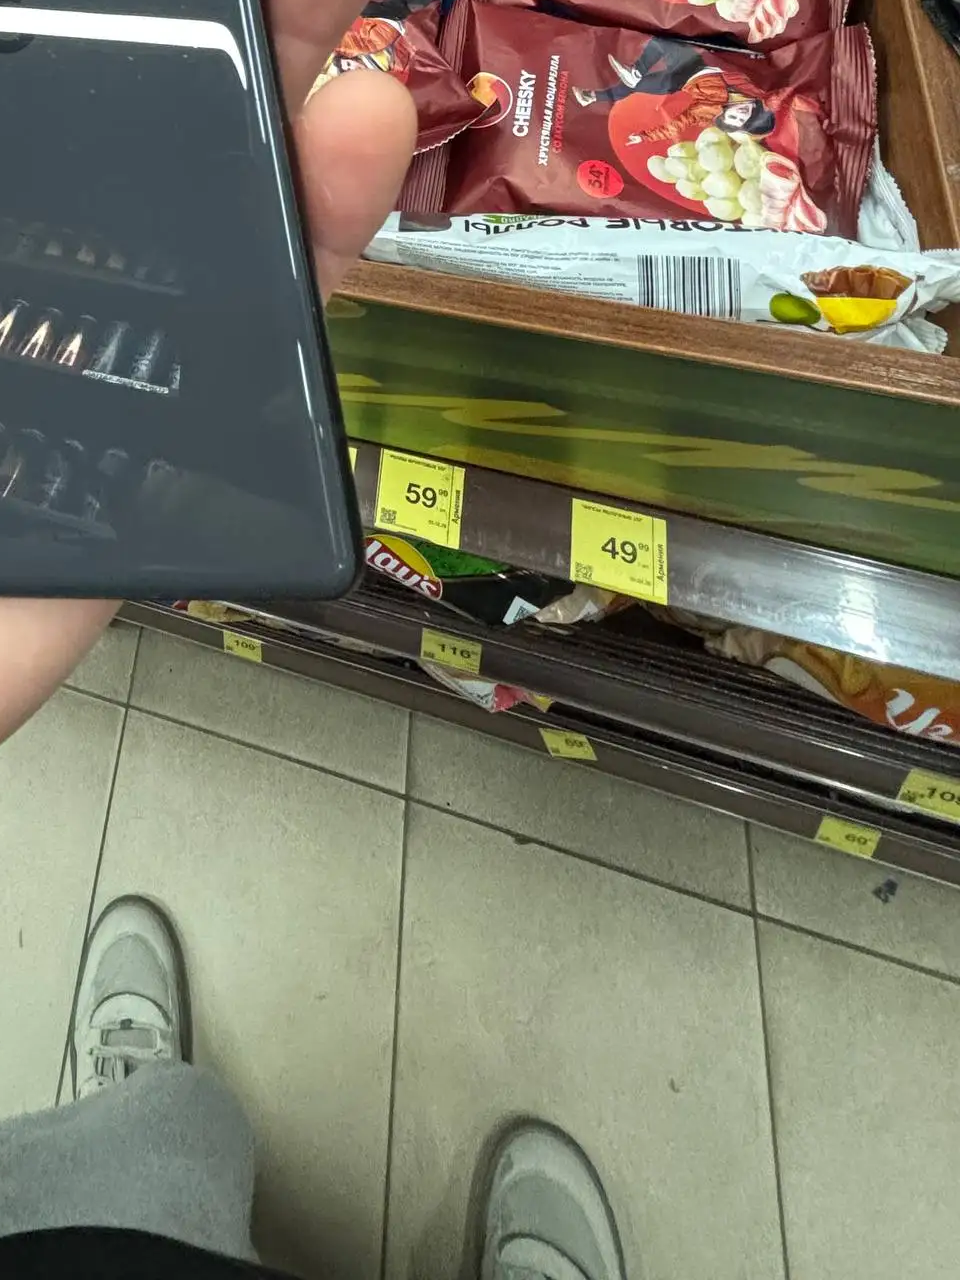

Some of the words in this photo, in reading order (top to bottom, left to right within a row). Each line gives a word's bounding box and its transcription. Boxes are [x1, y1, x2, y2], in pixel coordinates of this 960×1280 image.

[545, 55, 561, 113] МОЦАРЕЛЛА
[558, 70, 570, 103] БЕКОНА
[512, 69, 537, 138] CHEESKY
[537, 111, 554, 166] ХРУСТЯЩАЯ
[553, 103, 567, 141] ВКУСОМ
[552, 140, 562, 154] СО
[405, 482, 438, 509] 59
[452, 489, 461, 524] Армения
[601, 536, 638, 564] 49
[657, 543, 665, 583] Армения
